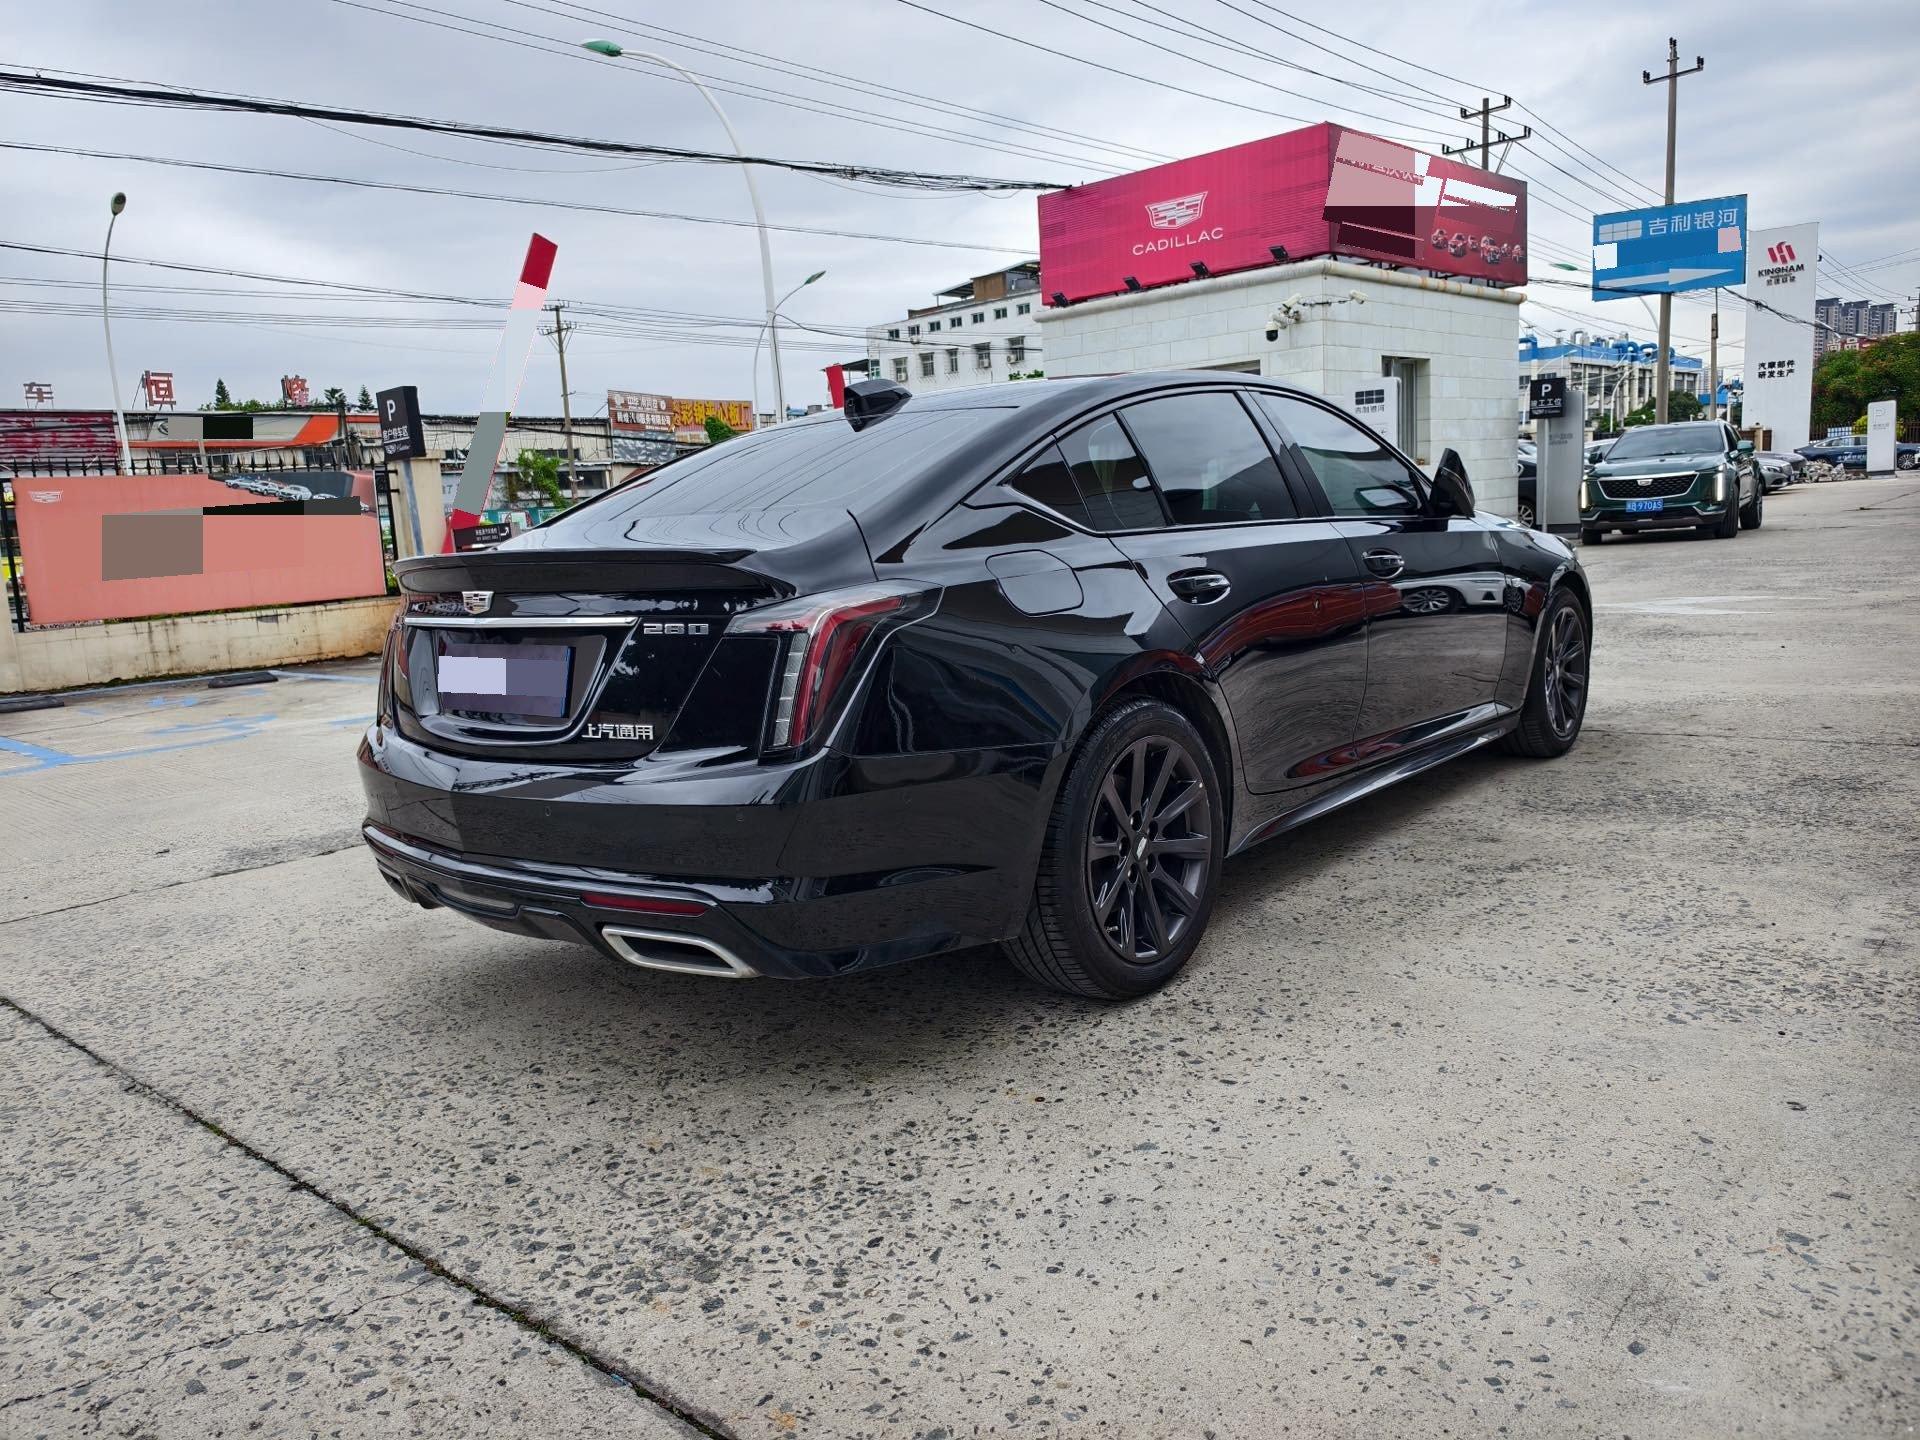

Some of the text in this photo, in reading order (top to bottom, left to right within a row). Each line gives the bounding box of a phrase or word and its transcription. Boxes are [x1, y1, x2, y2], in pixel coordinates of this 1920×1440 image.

[1648, 208, 1739, 236] 吉利银河
[1132, 227, 1224, 256] CADILLAC
[1758, 263, 1805, 277] KINGHAM
[1541, 384, 1552, 397] P
[386, 399, 396, 422] P
[581, 723, 654, 740] 上汽通用
